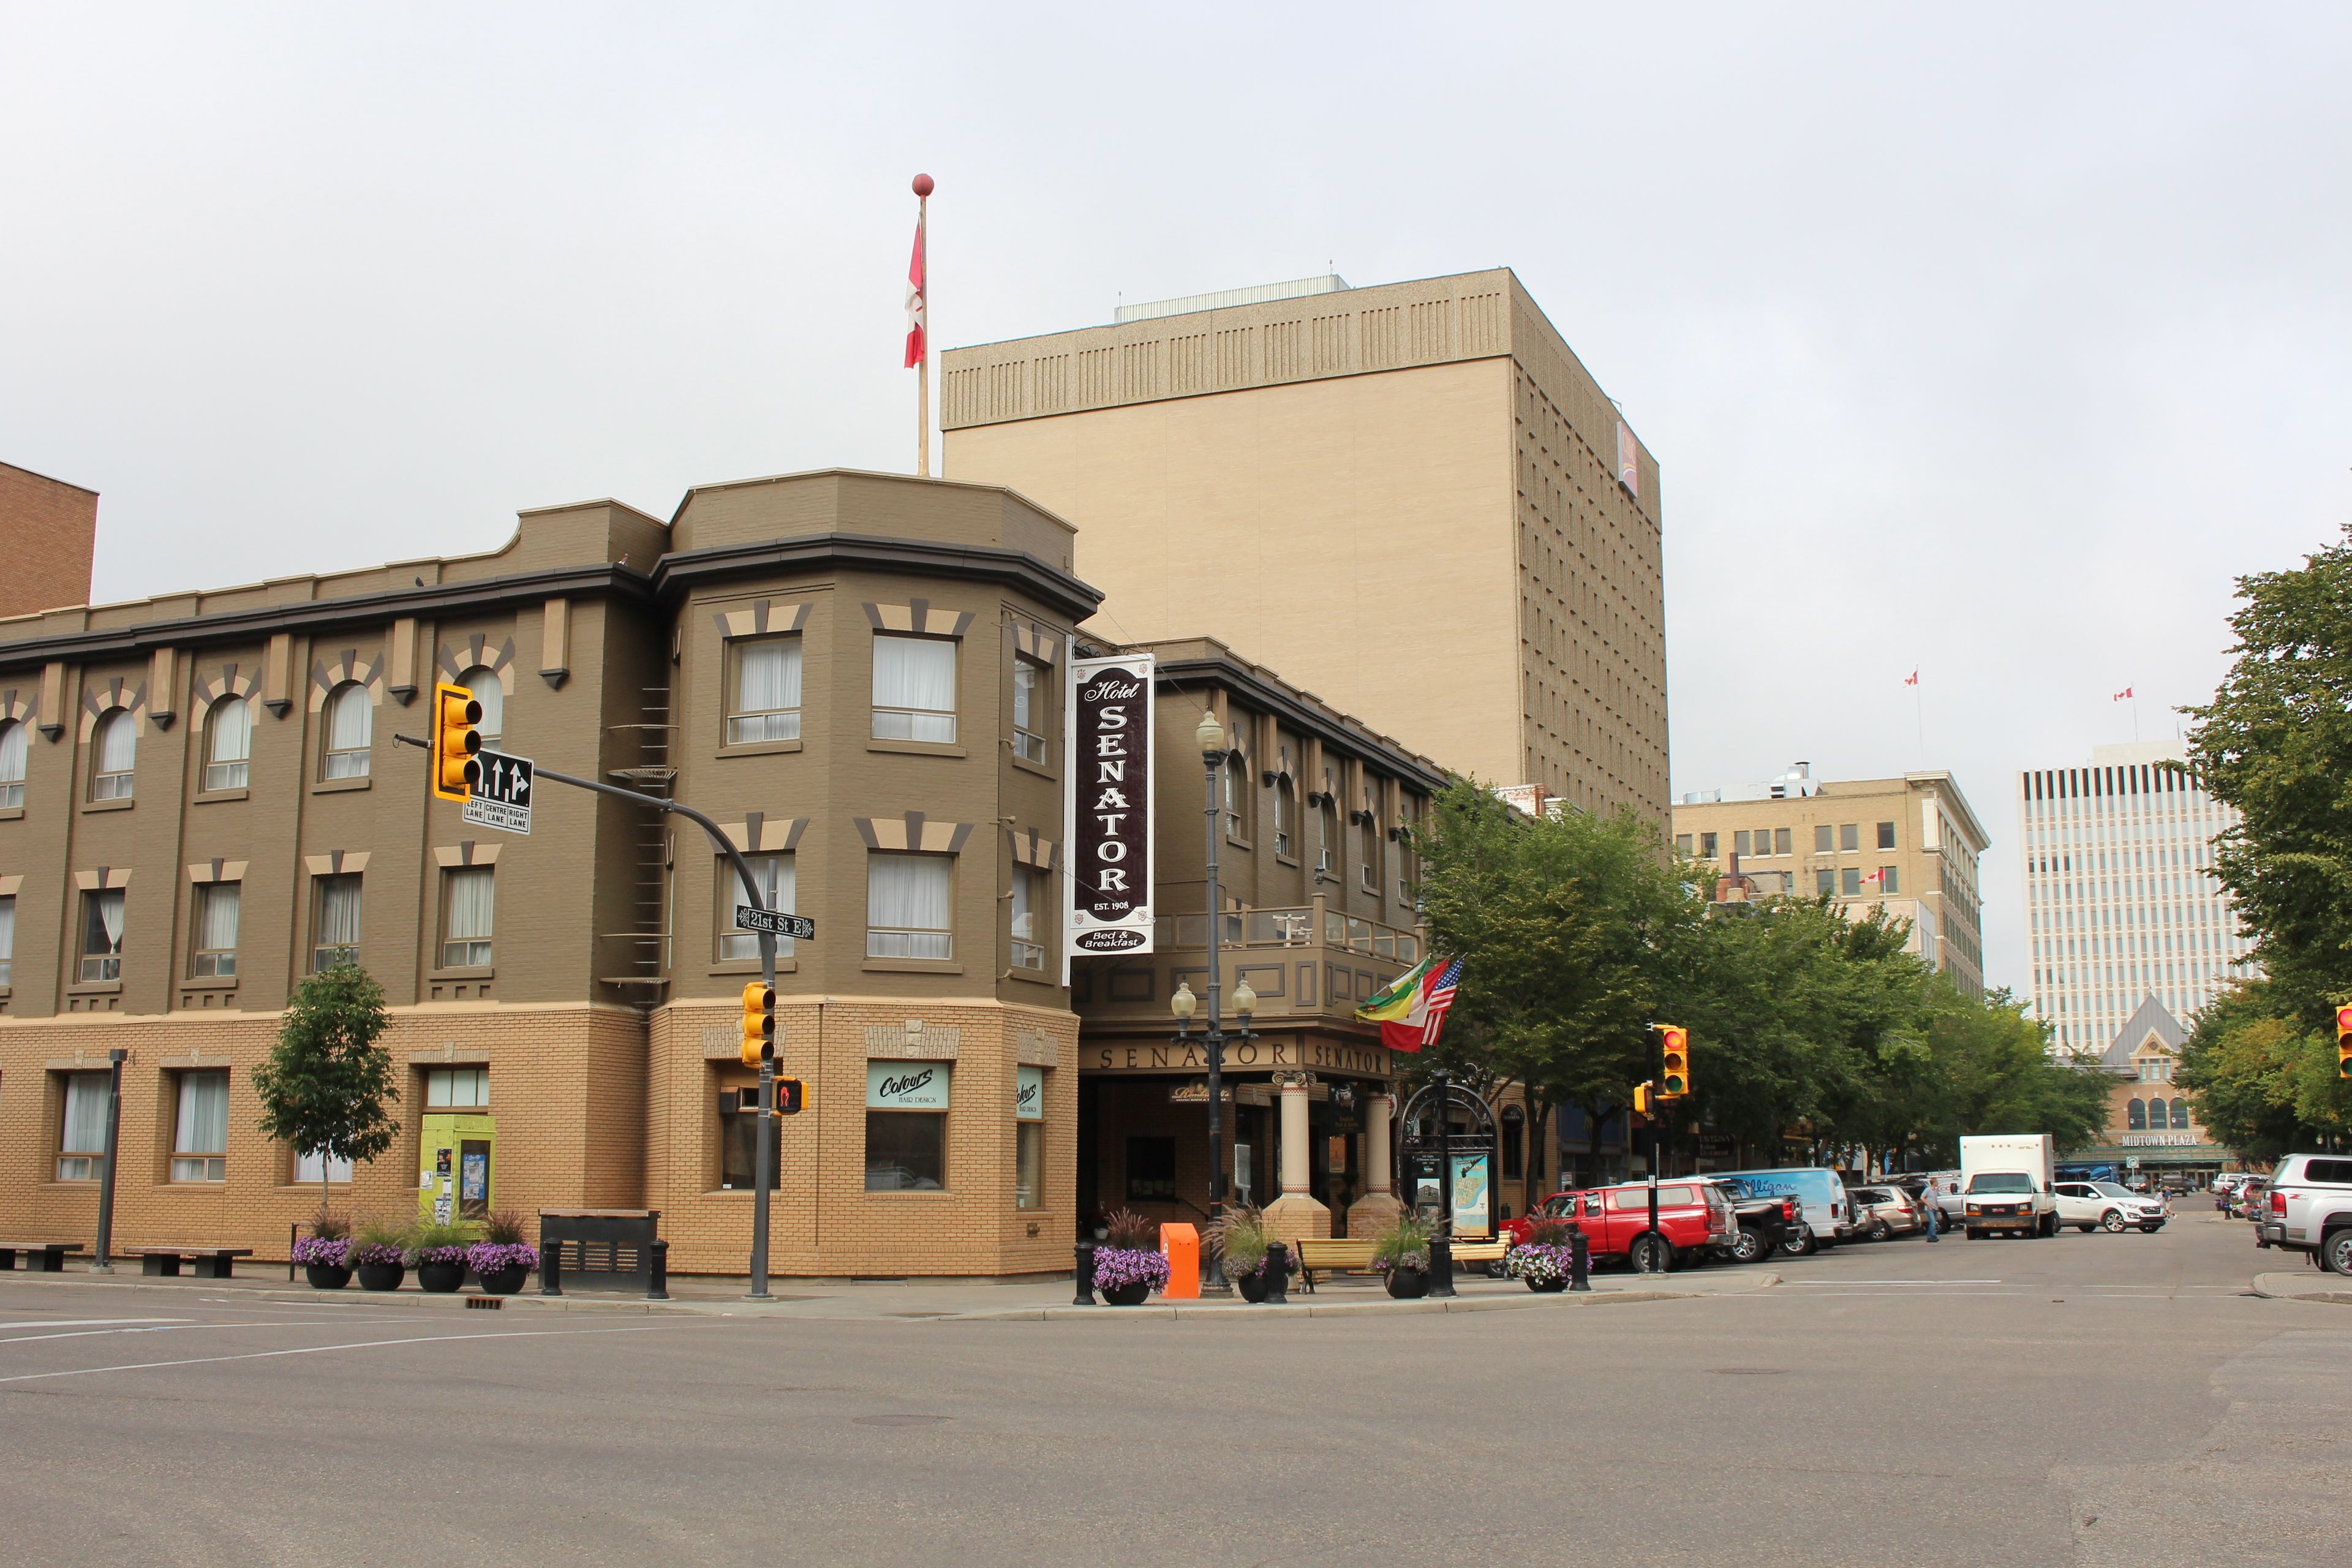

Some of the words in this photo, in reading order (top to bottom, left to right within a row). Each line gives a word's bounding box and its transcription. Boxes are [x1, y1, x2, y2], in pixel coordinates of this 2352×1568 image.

[1084, 680, 1140, 702] Hotel
[1093, 706, 1131, 892] SENATOR
[467, 801, 483, 809] LEFT
[486, 804, 507, 815] CENTRE
[466, 809, 483, 818] LANE
[488, 813, 504, 823] LANE
[509, 809, 527, 820] RIGHT
[510, 818, 526, 828] LANE
[1112, 901, 1129, 910] 1908
[750, 912, 772, 929] 21st
[777, 917, 789, 932] St
[793, 919, 801, 934] E
[1093, 931, 1116, 940] Bed
[1085, 938, 1138, 948] Breakfast
[1100, 1043, 1287, 1069] SENAOR
[1315, 1045, 1382, 1073] SENATOR
[880, 1069, 933, 1097] Colours
[1017, 1084, 1036, 1106] olours
[2122, 1136, 2165, 1147] MIDTOWN
[2168, 1135, 2197, 1146] PLAZA
[1750, 1179, 1797, 1196] lligan
